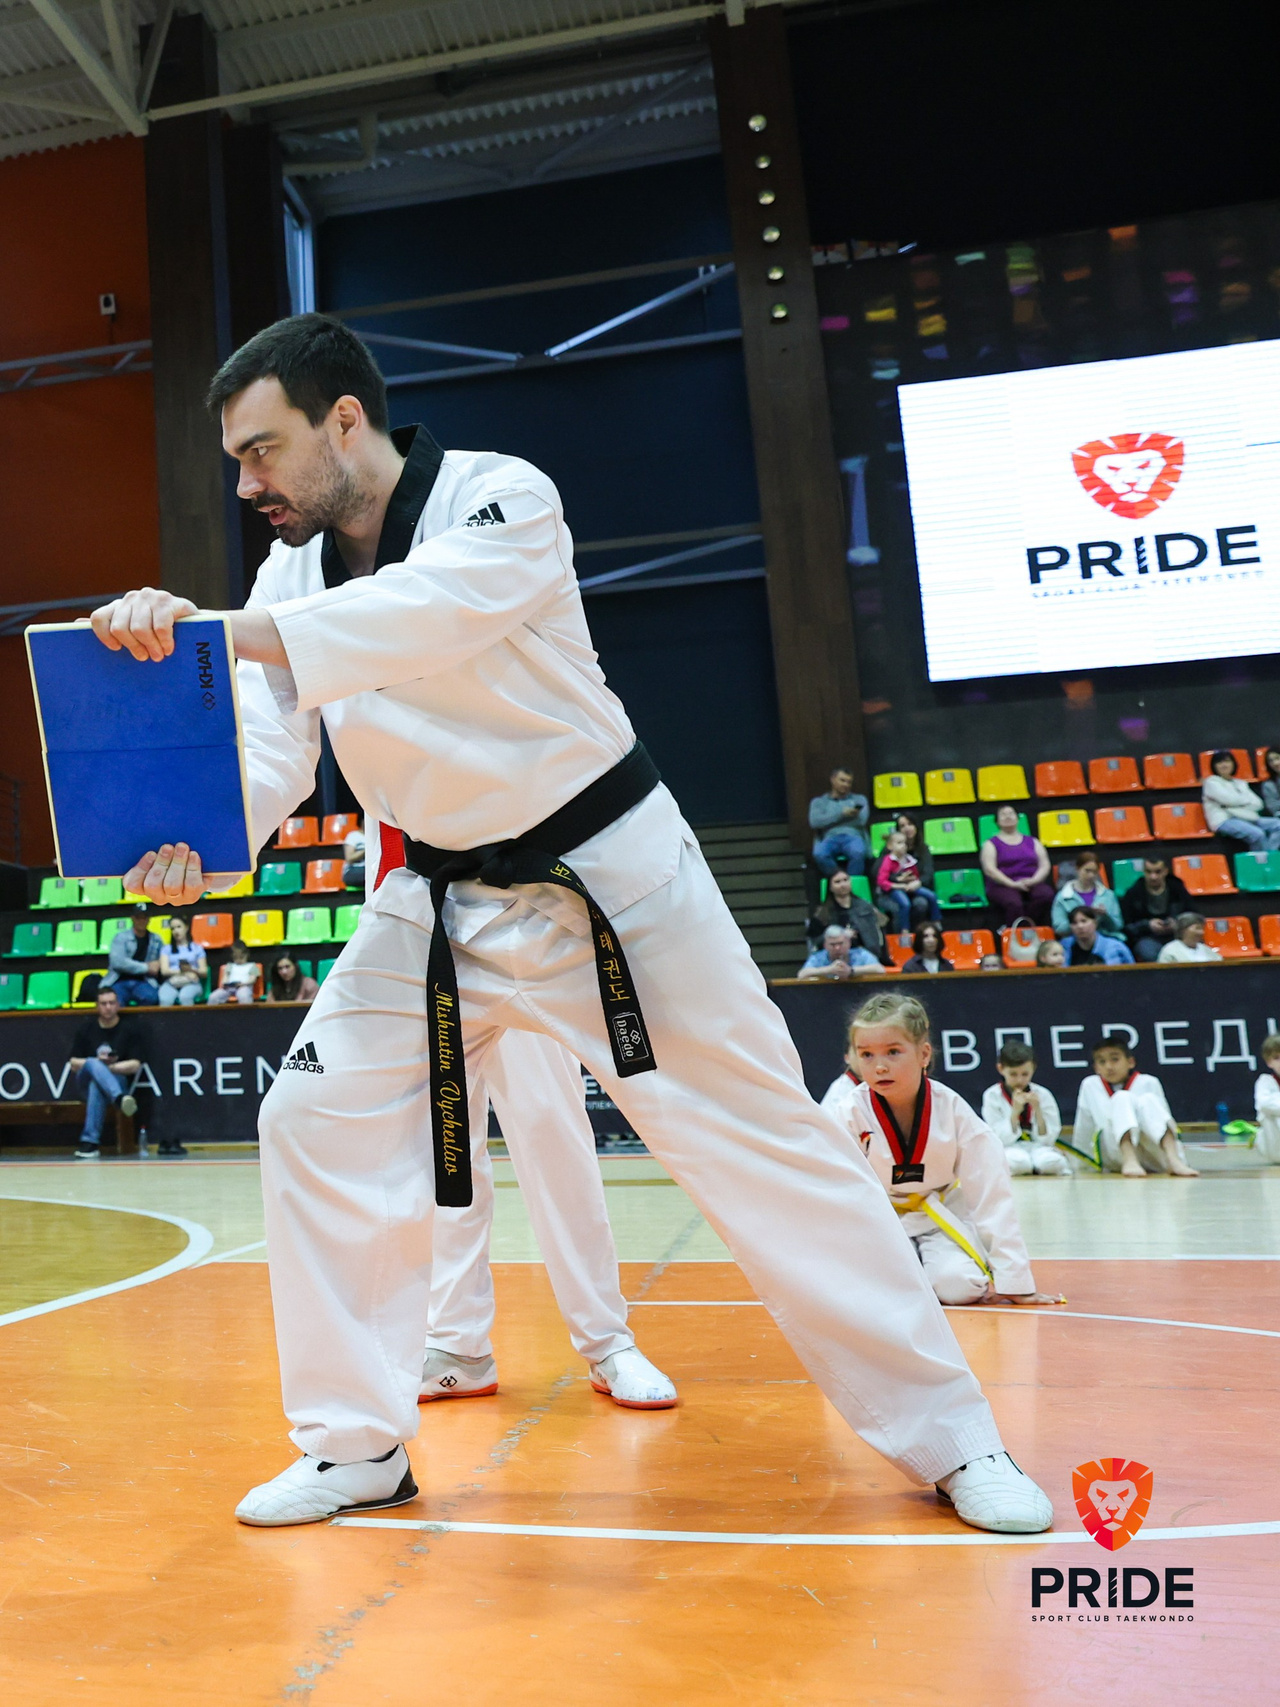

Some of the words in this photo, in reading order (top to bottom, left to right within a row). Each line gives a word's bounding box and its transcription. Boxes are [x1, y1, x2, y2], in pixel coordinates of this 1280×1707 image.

[1026, 524, 1261, 585] PRIDE
[195, 641, 215, 689] KHAN
[434, 982, 455, 1073] Mishustin
[616, 1019, 634, 1058] Daedo
[941, 1017, 1277, 1072] ВПЕРЕД
[129, 1056, 287, 1097] AREN
[283, 1060, 325, 1074] adidas
